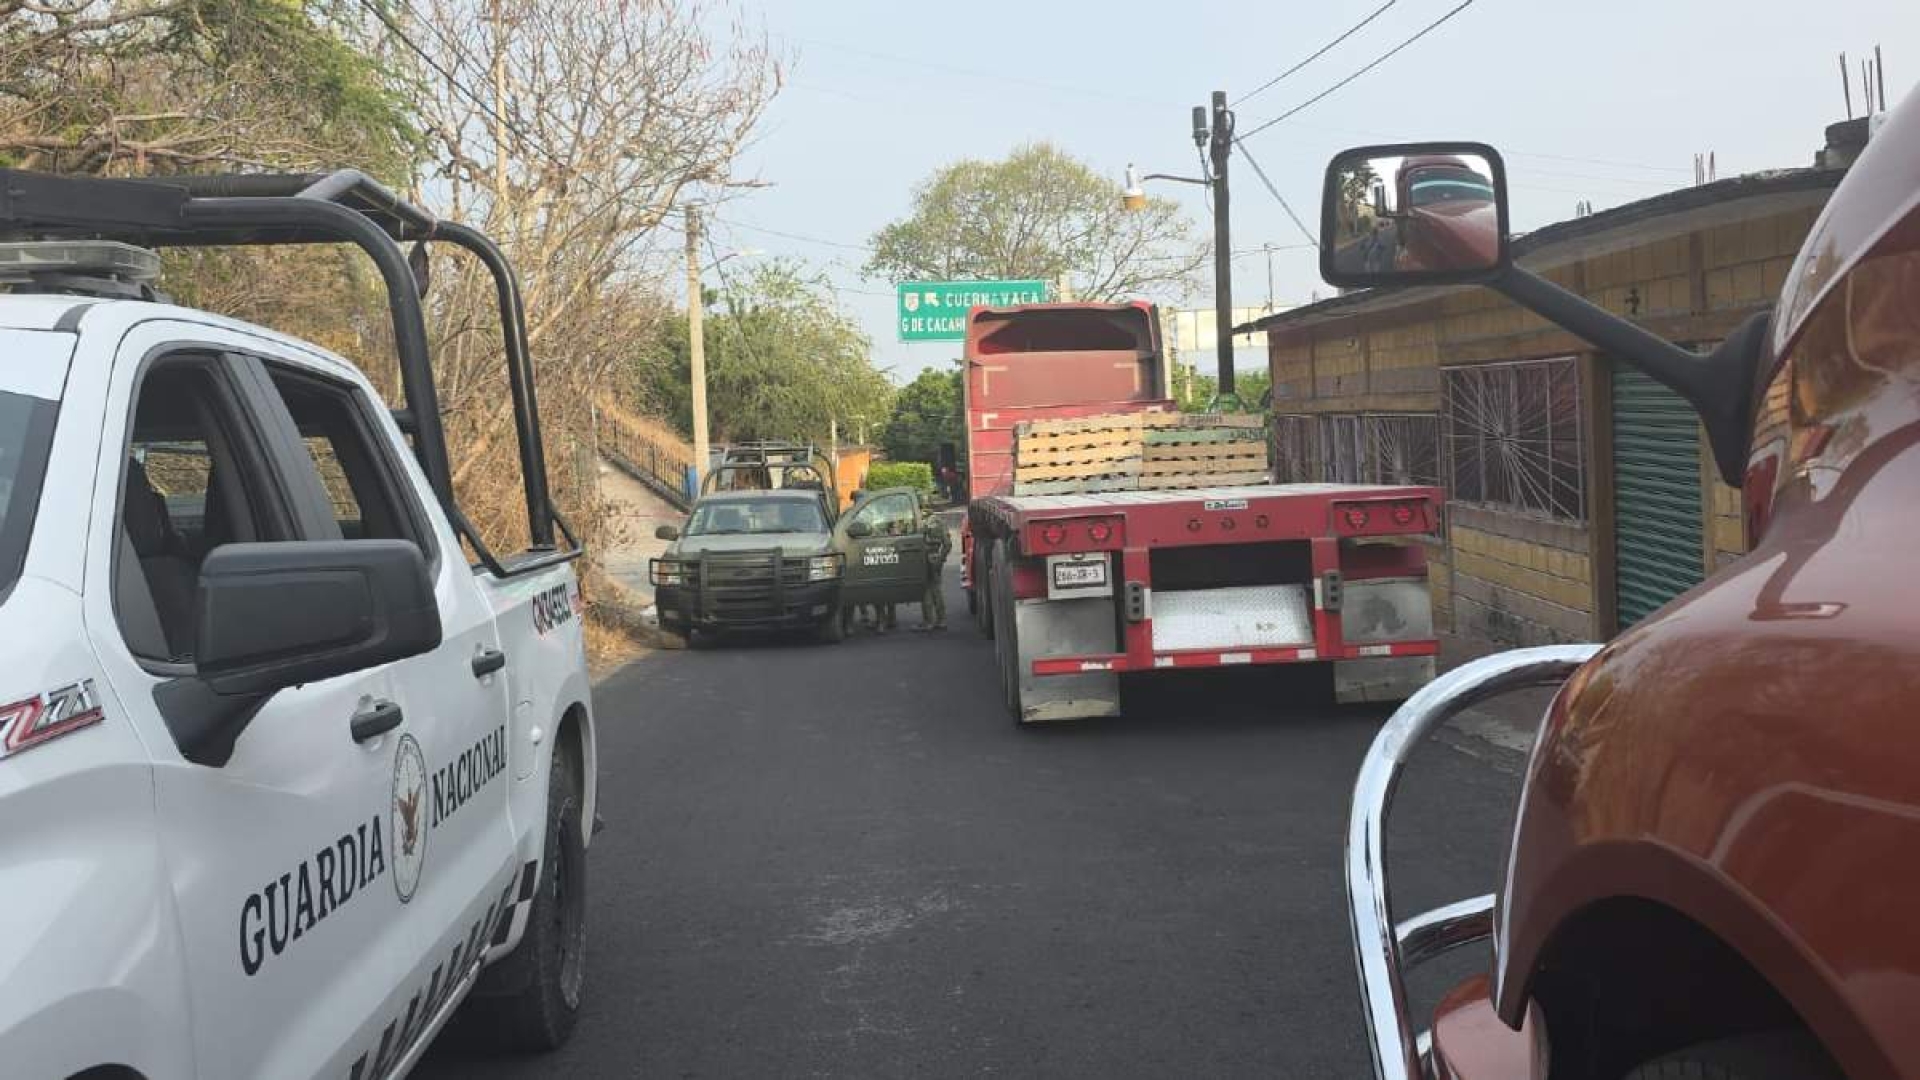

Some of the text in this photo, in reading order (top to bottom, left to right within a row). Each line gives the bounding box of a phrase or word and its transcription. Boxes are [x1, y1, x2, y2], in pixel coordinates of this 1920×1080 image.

[902, 316, 908, 332] G
[911, 316, 924, 332] DE
[239, 814, 385, 977] GUARDIA
[431, 724, 506, 829] NACIONAL
